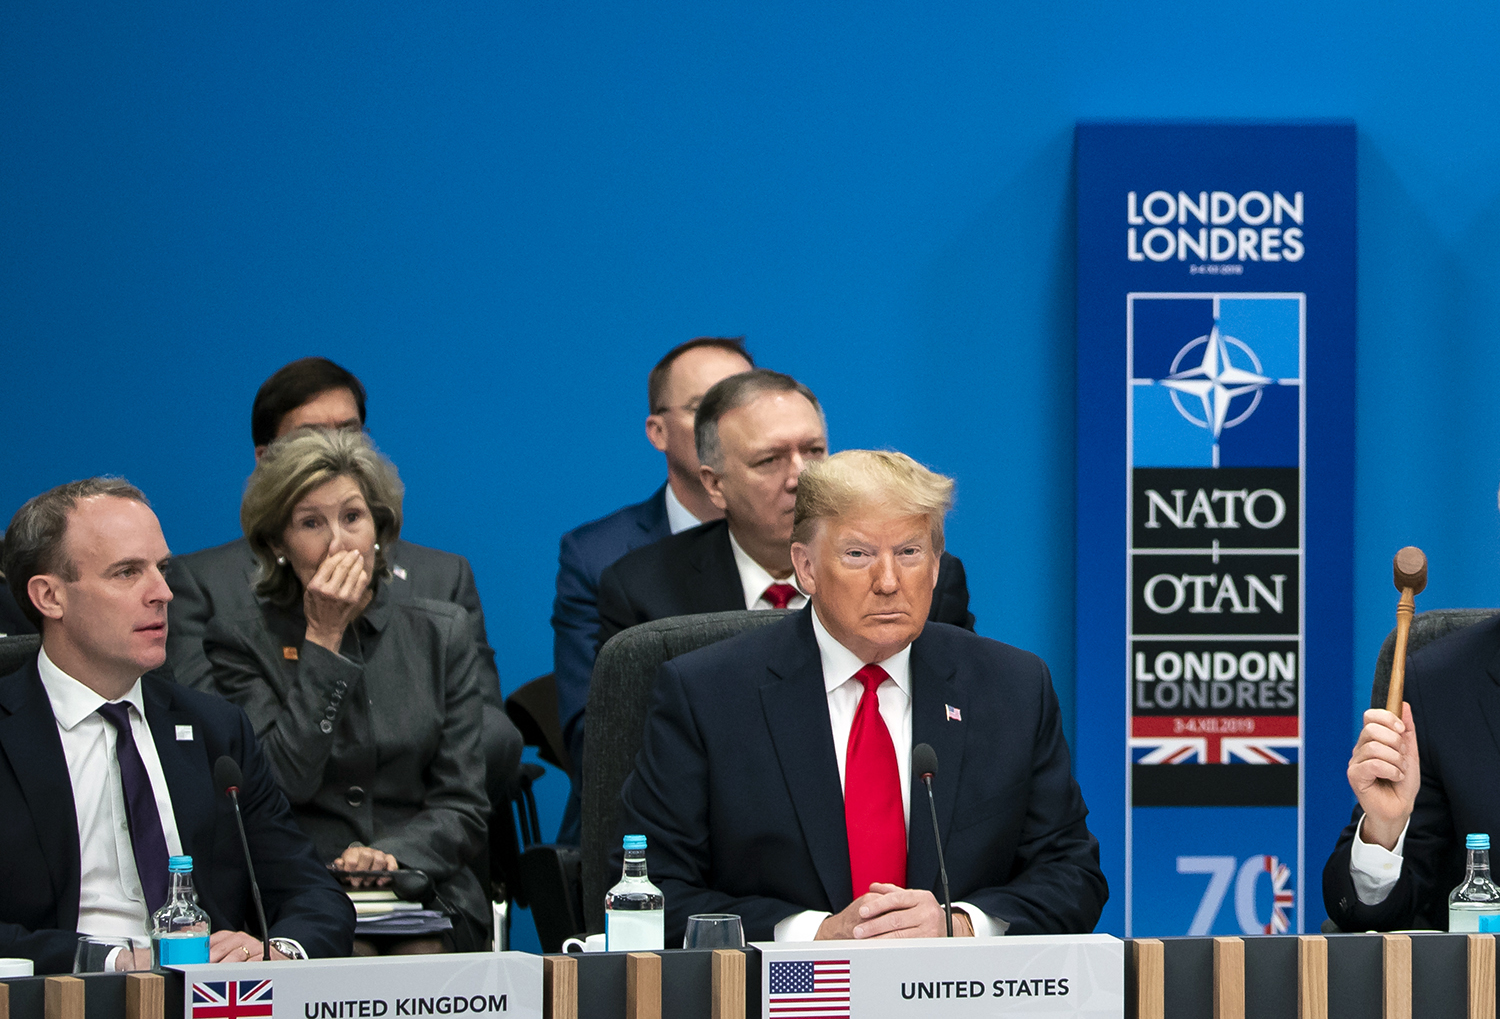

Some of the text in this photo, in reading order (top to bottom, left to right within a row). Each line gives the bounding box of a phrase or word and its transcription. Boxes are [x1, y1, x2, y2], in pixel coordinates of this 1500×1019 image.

[1127, 191, 1304, 225] LONDON
[1127, 227, 1305, 262] LONDRES
[1145, 488, 1286, 529] NATO
[1143, 573, 1287, 614] OTAN
[1135, 651, 1295, 682] LONDON
[1136, 682, 1295, 708] LONDRES
[901, 978, 1070, 1000] UNITED STATES
[304, 994, 508, 1019] UNITED KINGDOM
